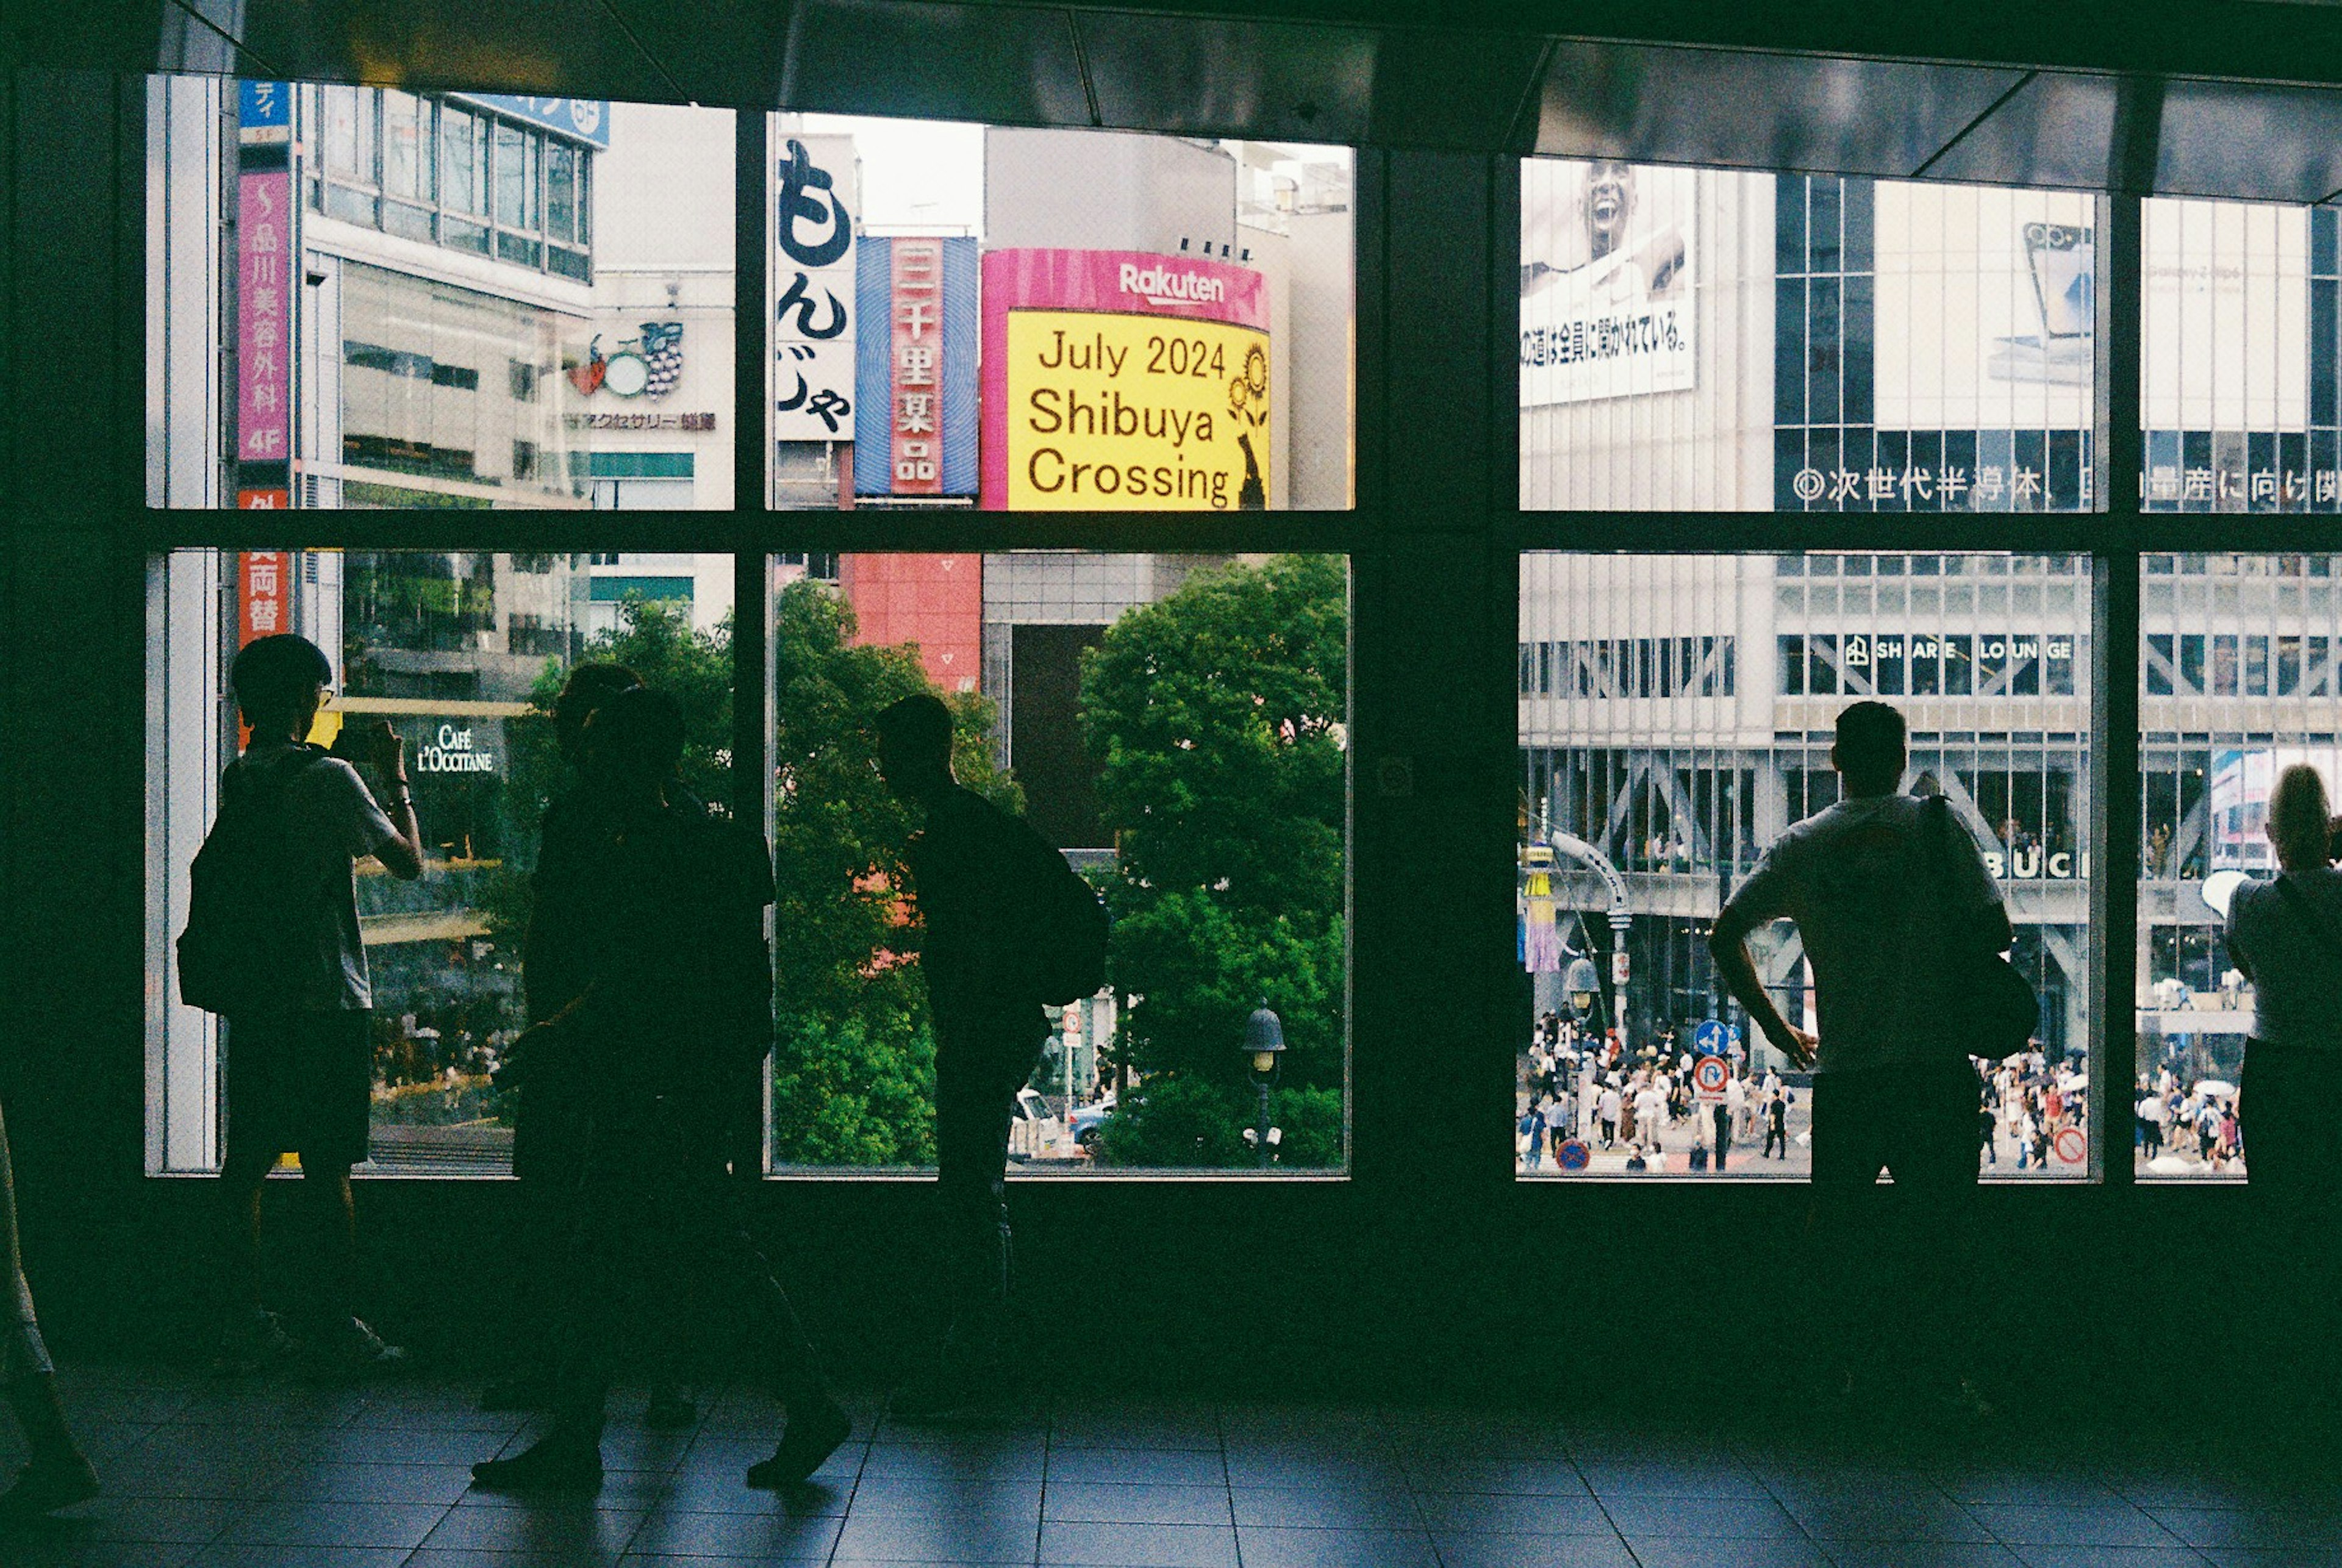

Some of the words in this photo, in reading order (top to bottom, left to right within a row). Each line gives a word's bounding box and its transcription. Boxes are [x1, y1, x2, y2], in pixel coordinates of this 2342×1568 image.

[1120, 263, 1224, 302] Rakuten
[251, 223, 278, 412] 品川美容外科
[897, 246, 936, 480] 三千里薬品
[1039, 330, 1129, 378] July
[1147, 335, 1225, 379] 2024
[248, 429, 281, 453] 4F
[1029, 388, 1213, 448] Shibuya
[1028, 448, 1228, 509] Crossing
[1877, 642, 1956, 659] SHARE
[1979, 642, 2071, 659] LOUNGE
